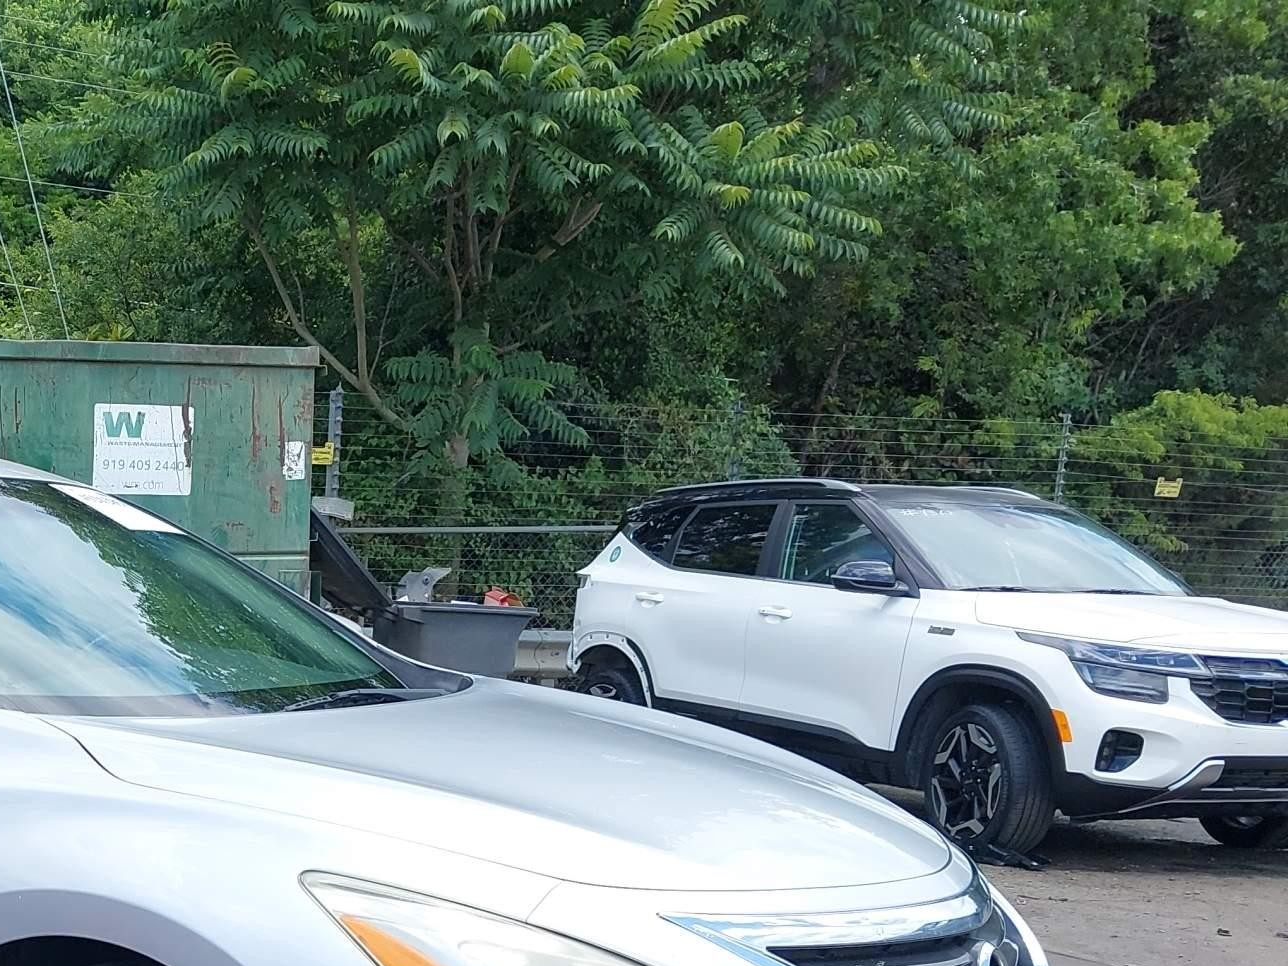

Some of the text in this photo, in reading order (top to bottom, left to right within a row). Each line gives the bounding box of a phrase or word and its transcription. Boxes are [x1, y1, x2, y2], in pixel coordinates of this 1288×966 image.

[102, 459, 185, 471] 919 405 2440
